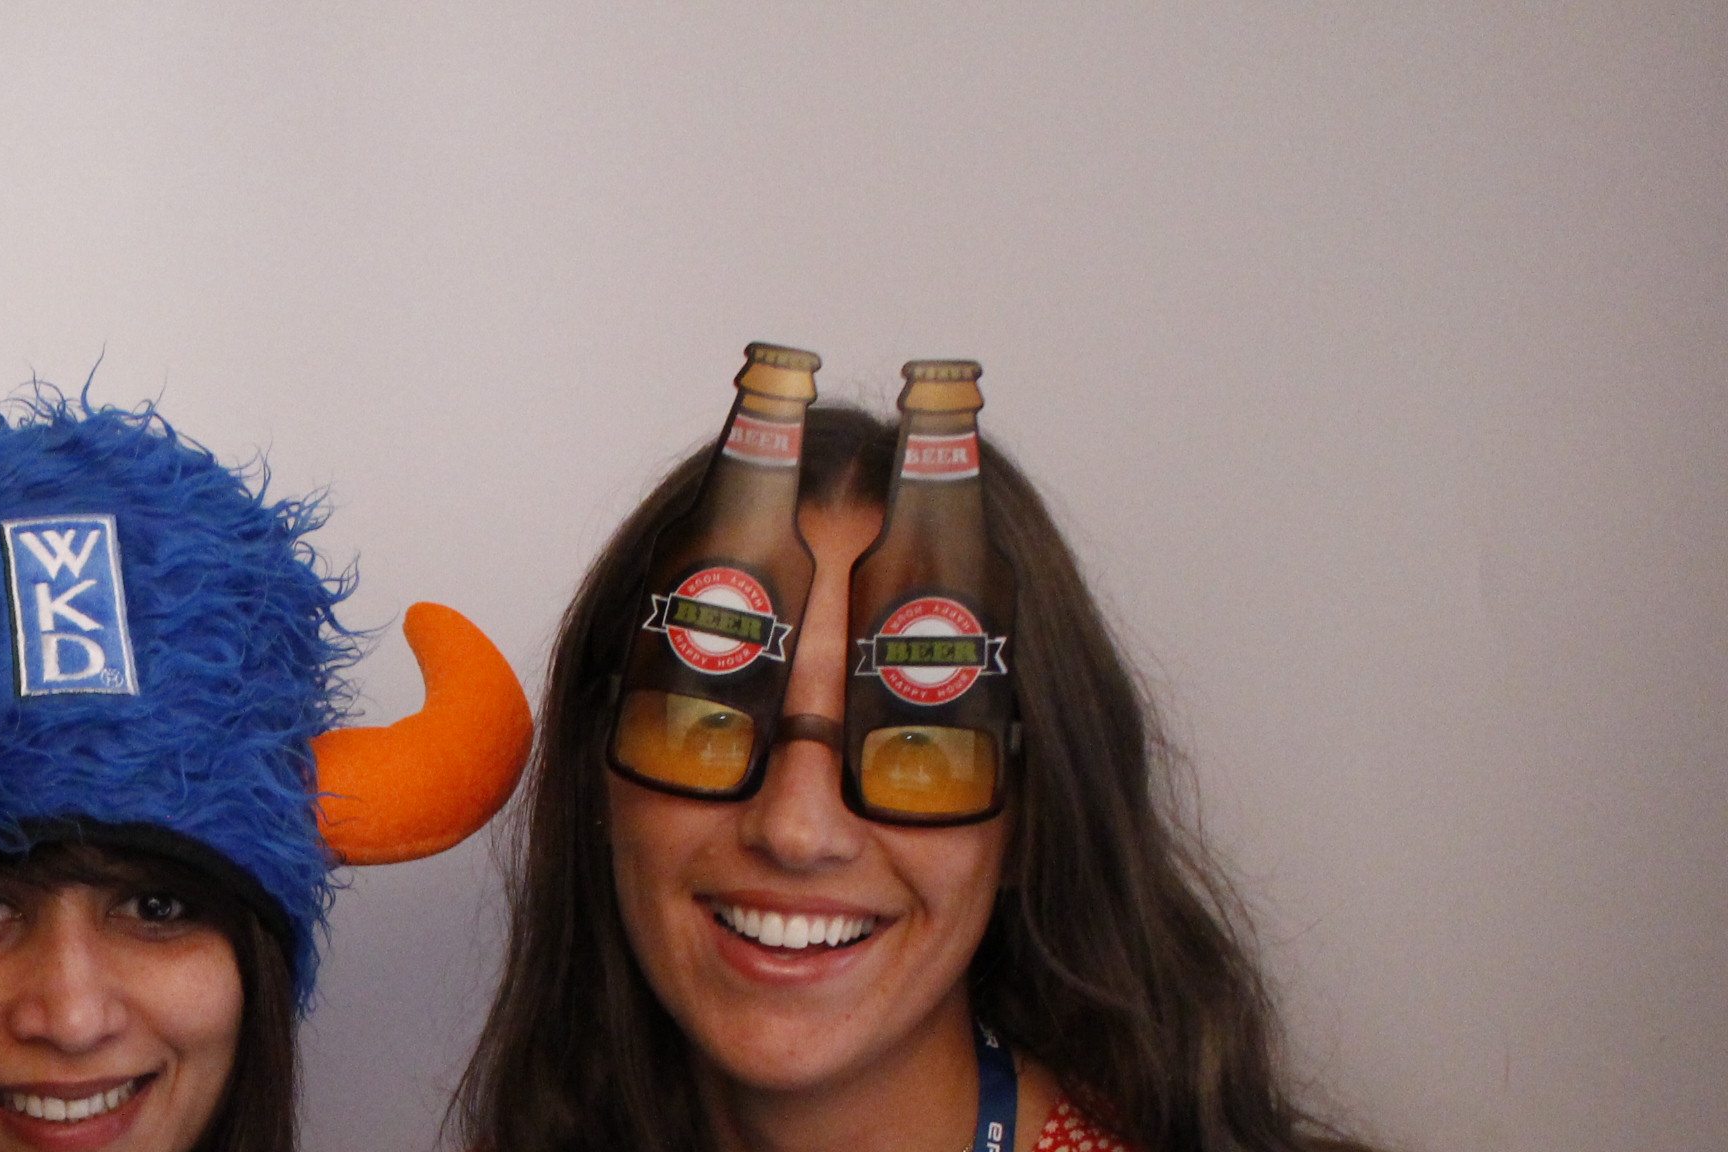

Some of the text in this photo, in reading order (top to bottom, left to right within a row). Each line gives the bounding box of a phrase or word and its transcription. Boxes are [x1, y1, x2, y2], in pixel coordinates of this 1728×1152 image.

[729, 425, 790, 451] BEER
[904, 447, 969, 465] BEER
[674, 600, 763, 640] BEER
[885, 641, 979, 662] BEER
